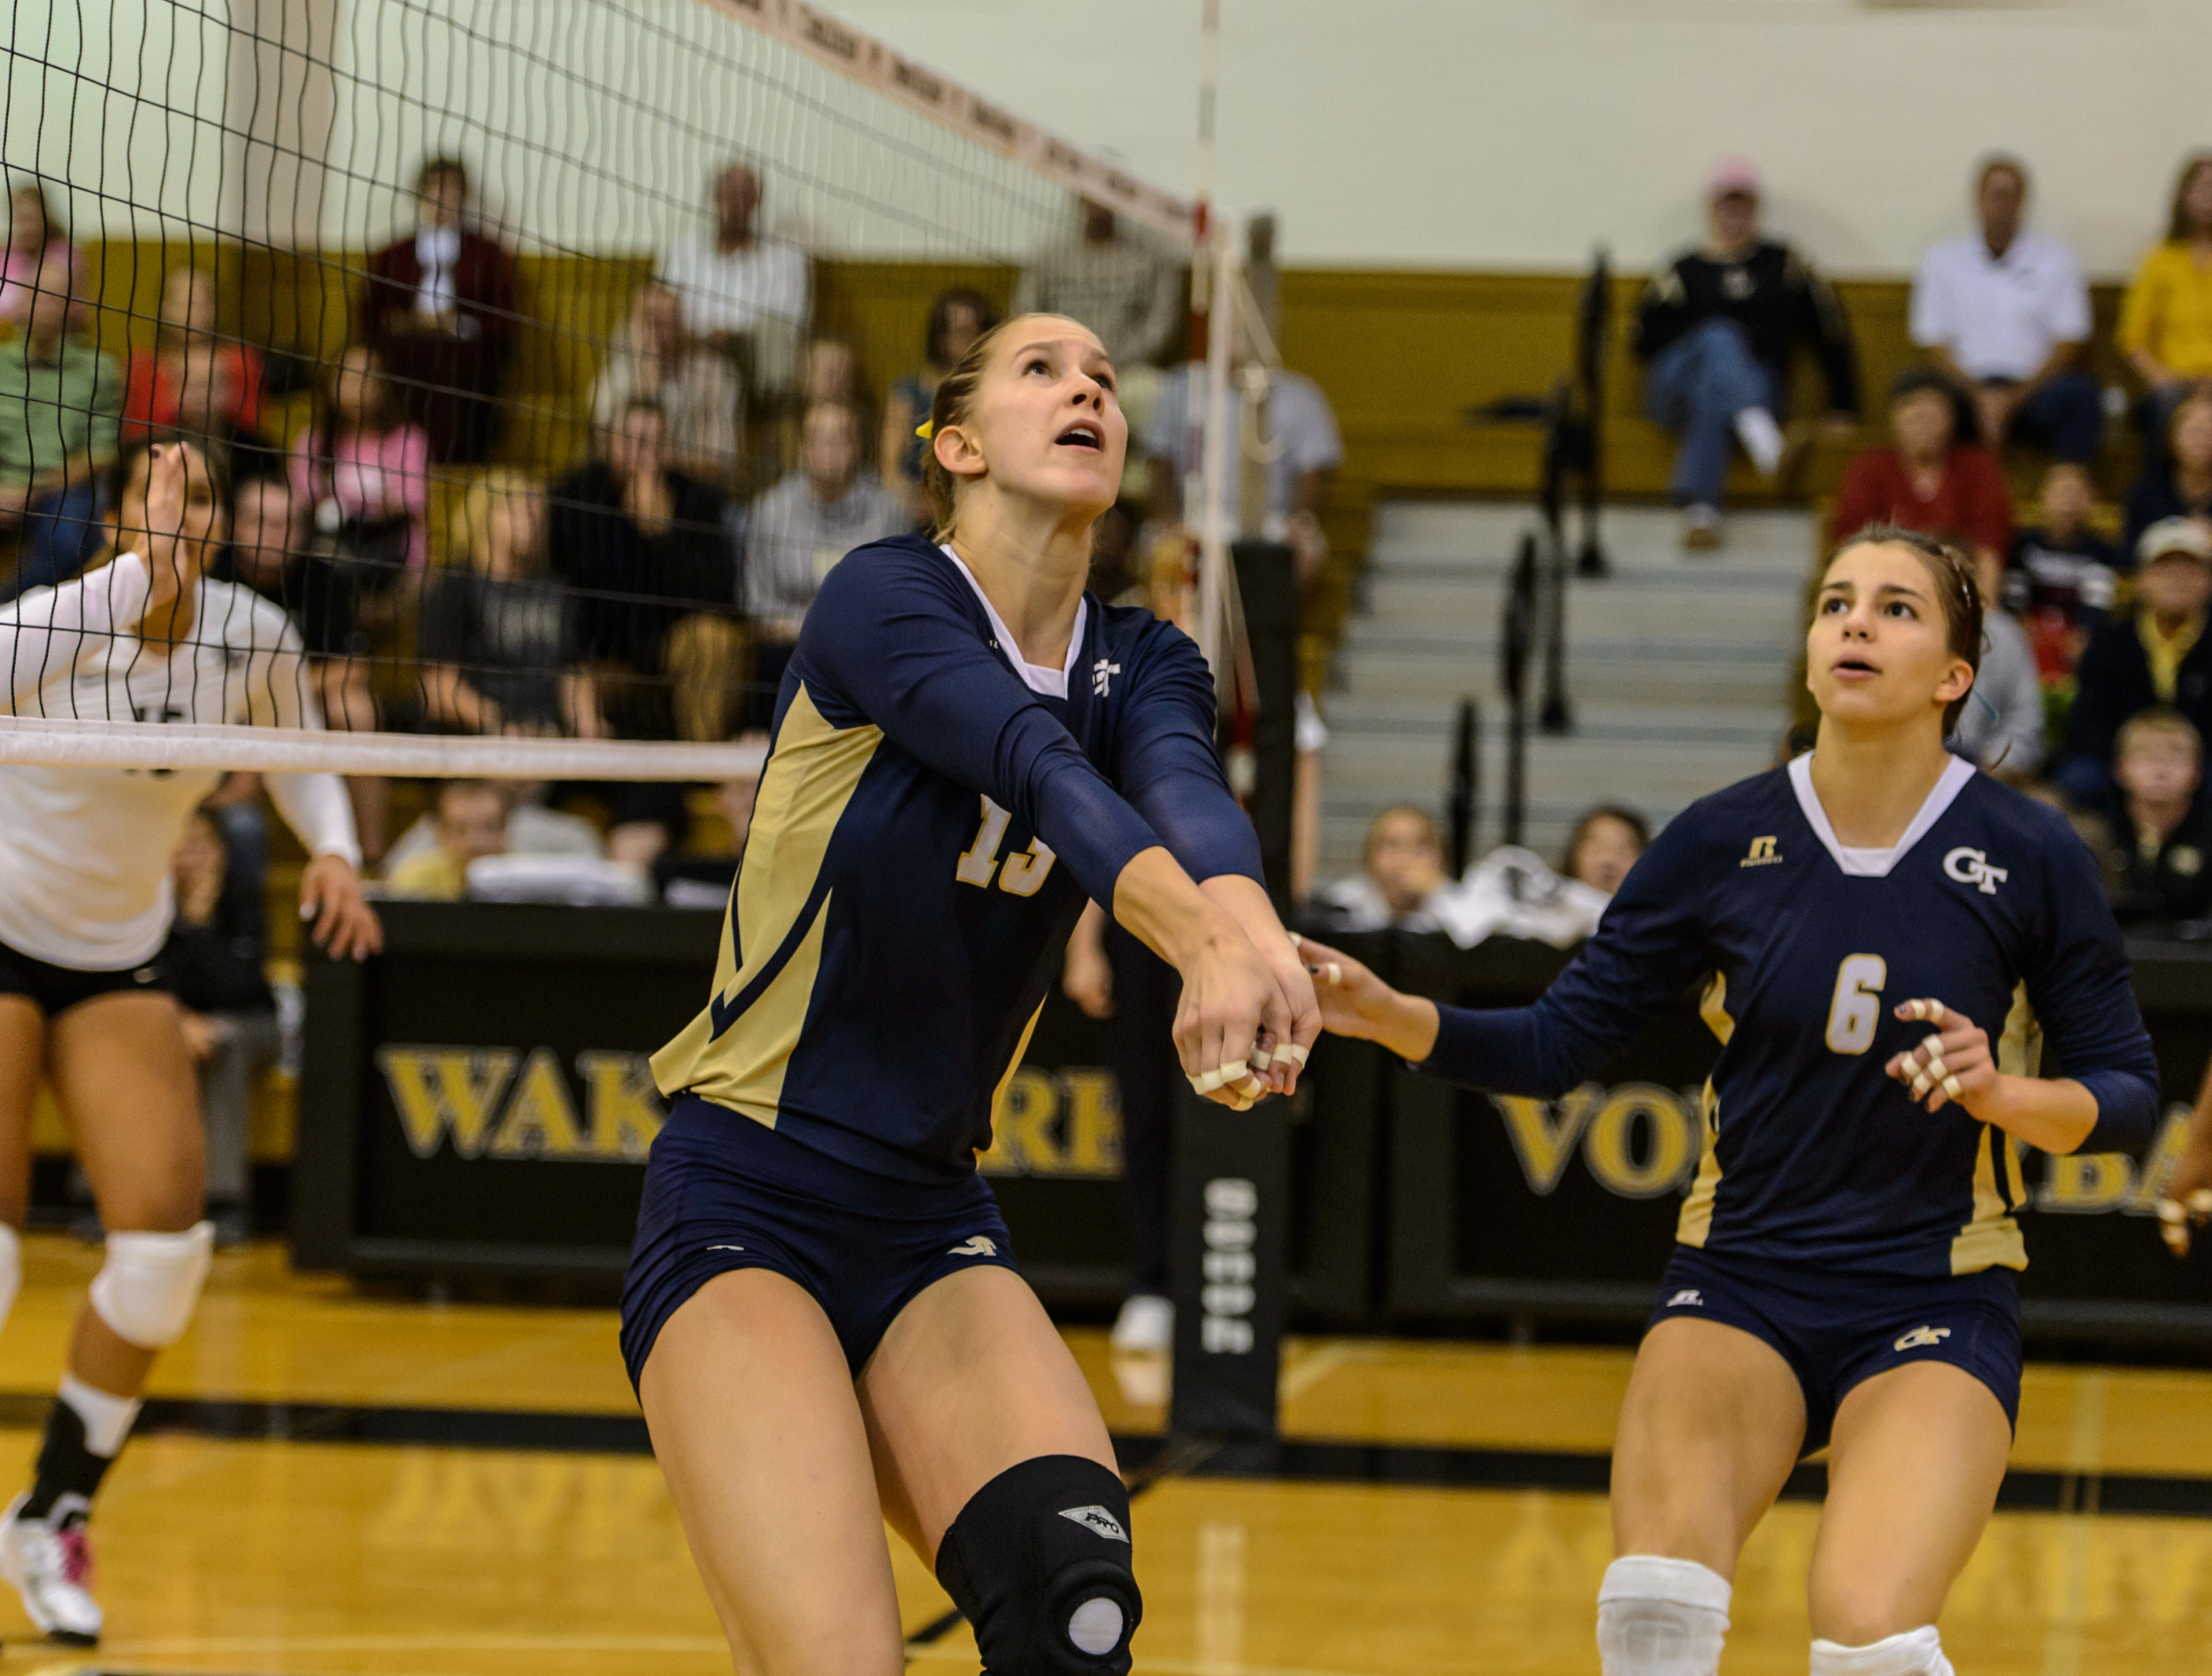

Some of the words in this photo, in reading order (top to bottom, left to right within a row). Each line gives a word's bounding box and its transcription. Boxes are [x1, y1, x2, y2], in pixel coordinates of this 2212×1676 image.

[1943, 846, 2008, 896] GT
[1824, 953, 1887, 1056] 6
[376, 1044, 671, 1164] WAK
